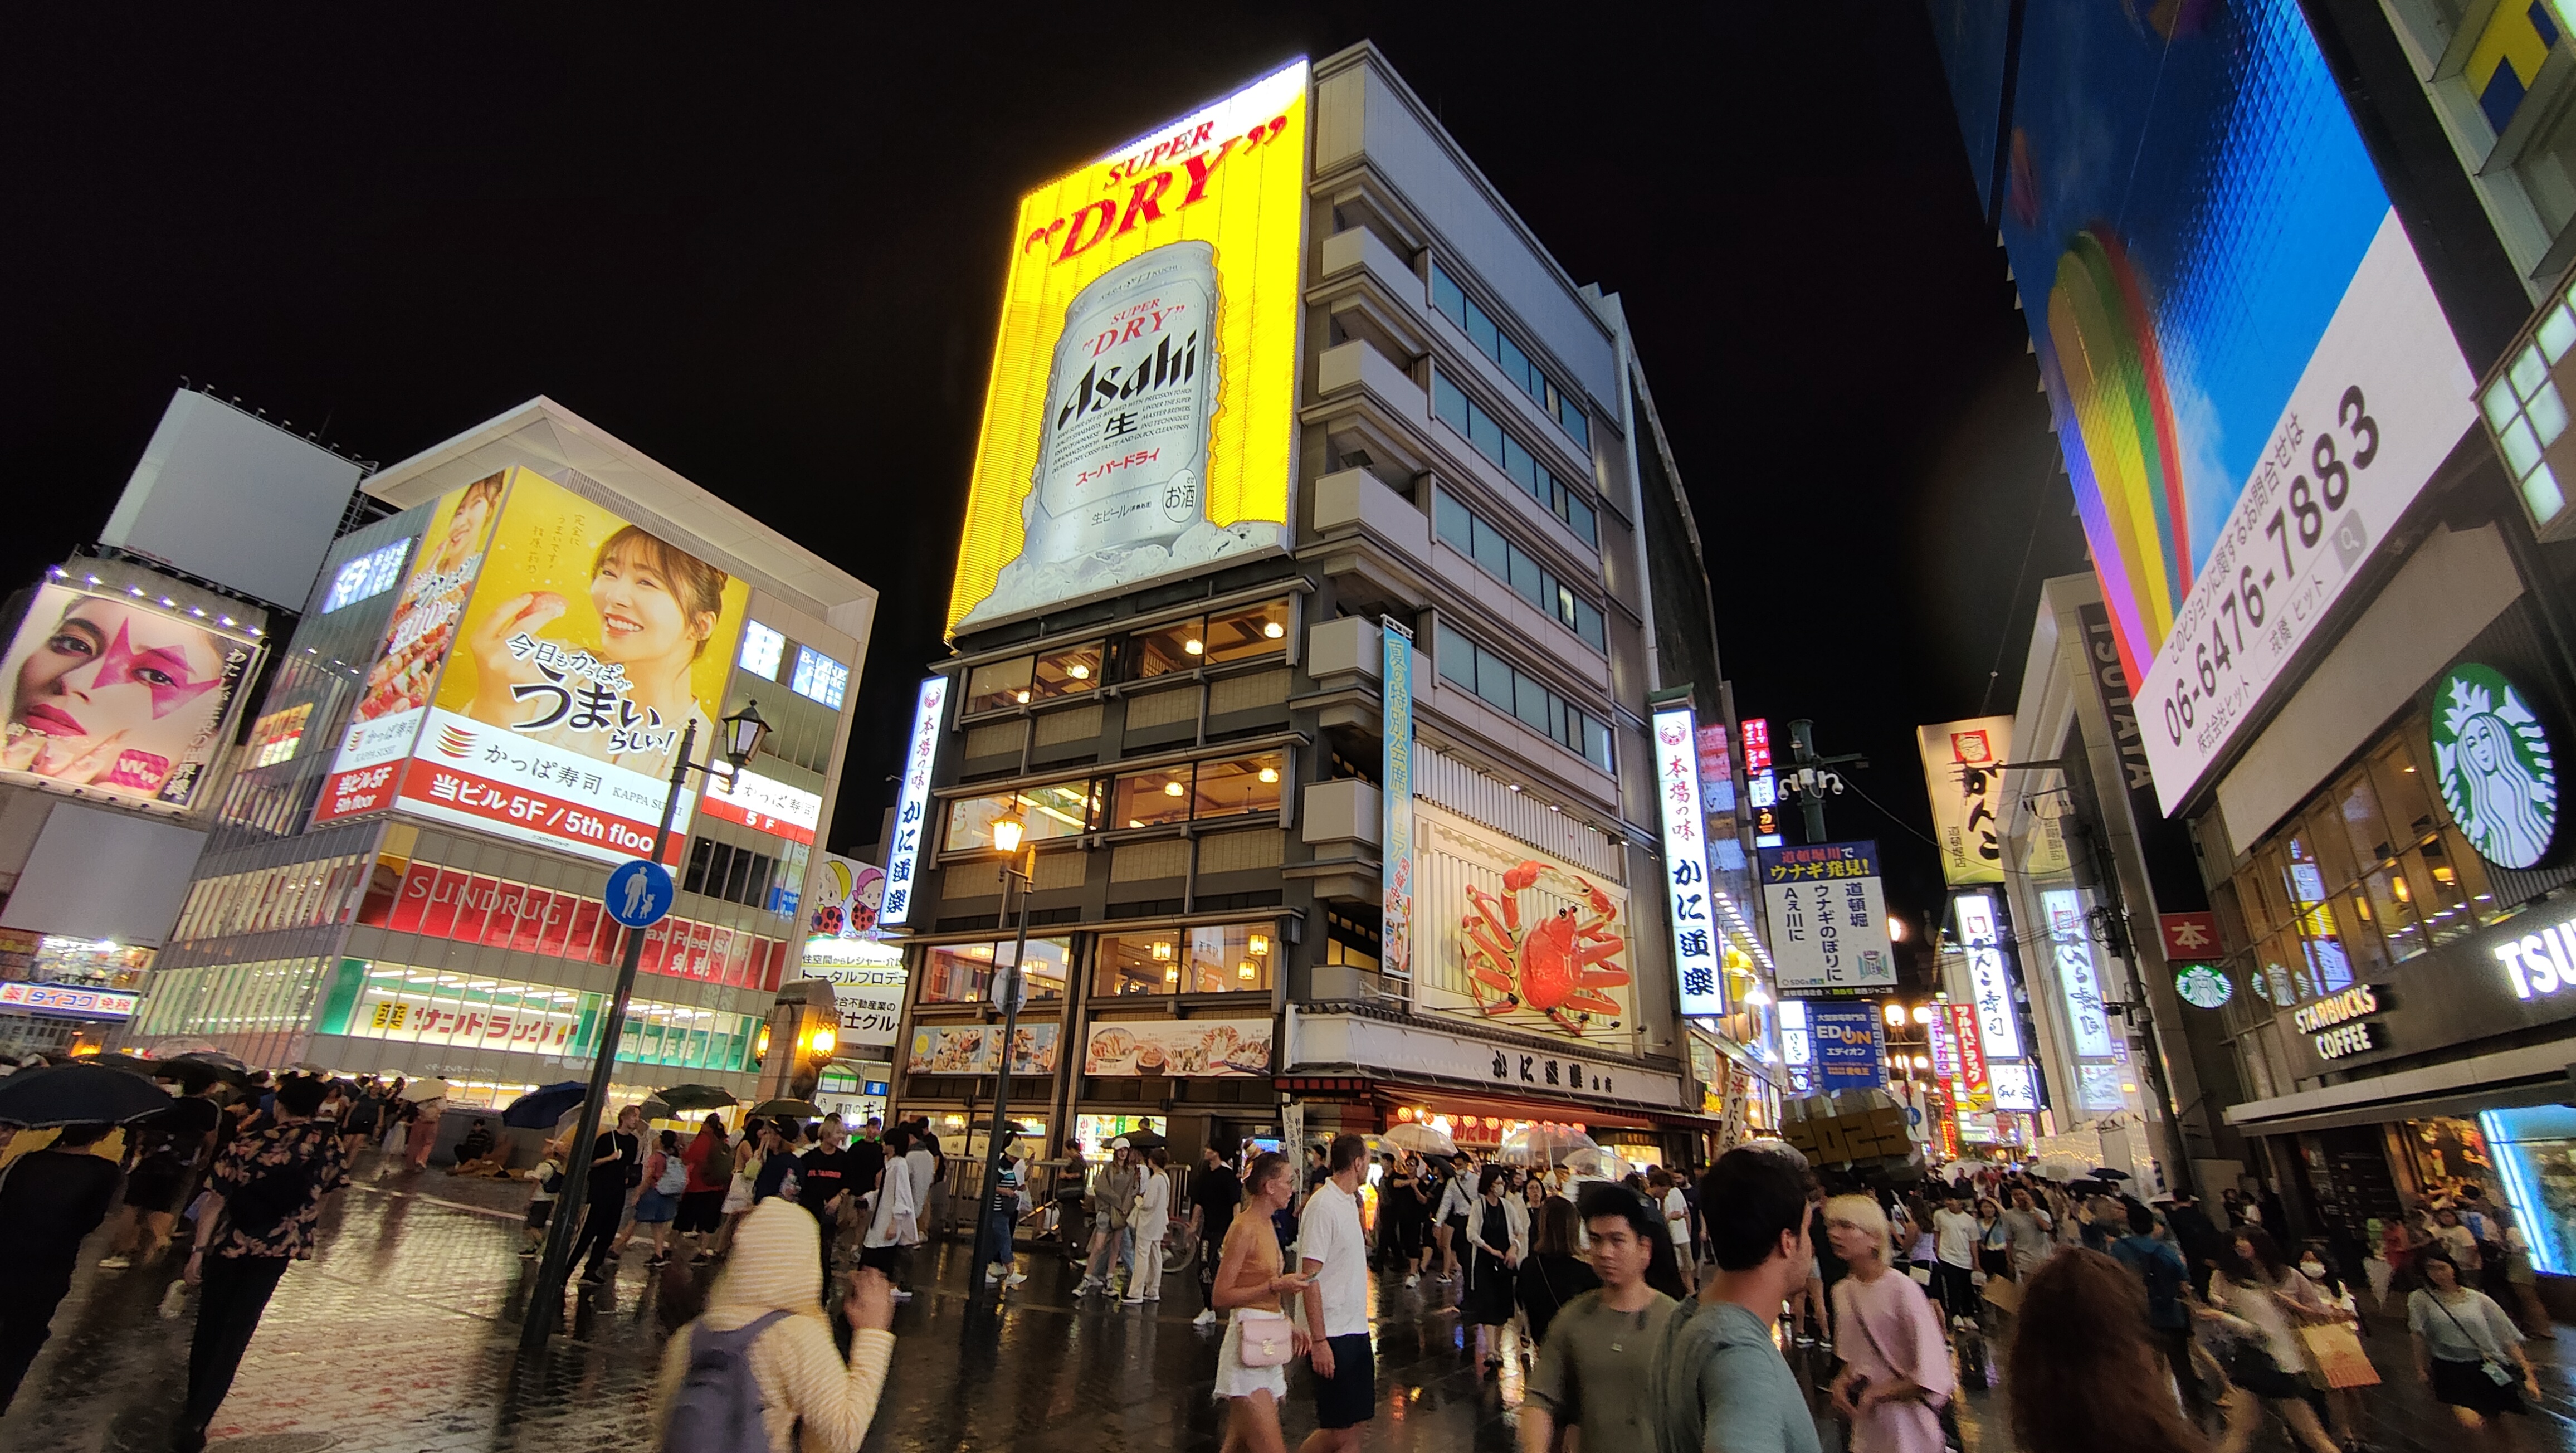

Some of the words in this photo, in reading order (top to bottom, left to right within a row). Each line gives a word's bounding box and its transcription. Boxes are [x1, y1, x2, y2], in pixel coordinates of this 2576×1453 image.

[1103, 121, 1214, 191] SUPER
[1111, 298, 1160, 325] SUPER
[1057, 328, 1197, 431] Asahi
[1103, 412, 1138, 441] 生
[1076, 447, 1160, 487] スーパードライ
[1165, 485, 1195, 509] お酒
[2170, 411, 2305, 665] このビジョンに関するお問合せは
[2163, 384, 2380, 748] 06-6476-7883
[2293, 573, 2324, 623] ヒット
[507, 632, 633, 691] 今日もかっぱが
[511, 663, 662, 732] うまい
[2196, 674, 2251, 758] 株式会社ヒット
[608, 729, 677, 754] らしい!
[910, 715, 934, 791] 本場の味
[1389, 640, 1407, 860] 夏の特別会席フェア
[484, 744, 603, 794] かっぱ寿司
[612, 787, 648, 806] KAPPA
[651, 799, 683, 816] SUI
[743, 783, 816, 819] かっぱ寿司
[1665, 755, 1695, 842] 本場の味
[564, 811, 605, 840] 5th
[608, 823, 655, 852] floo
[885, 800, 921, 914] かに道楽
[1391, 856, 1412, 899] 開催中
[1770, 859, 1870, 881] ウナギ発見!
[1781, 846, 1855, 864] 道頓堀川で
[408, 875, 562, 925] SUNDRUG
[1845, 882, 1869, 928] 道頓堀
[646, 928, 667, 943] ax
[672, 930, 709, 950] Free
[1672, 859, 1715, 997] かに道楽
[1814, 884, 1844, 982] ウナギのぼりに
[2171, 921, 2210, 950] 本
[670, 952, 712, 977] 免税
[2494, 918, 2576, 998] TSU
[413, 1006, 554, 1043] サンドラッグ
[835, 1009, 900, 1032] 士グル
[2294, 983, 2377, 1035] STARBUCKS
[1816, 1025, 1872, 1045] EDION
[1826, 1047, 1866, 1056] エディオン
[1954, 1005, 1983, 1083] ツルハドラッグ
[2315, 1022, 2373, 1060] COFFEE
[1492, 1050, 1583, 1089] かに道楽
